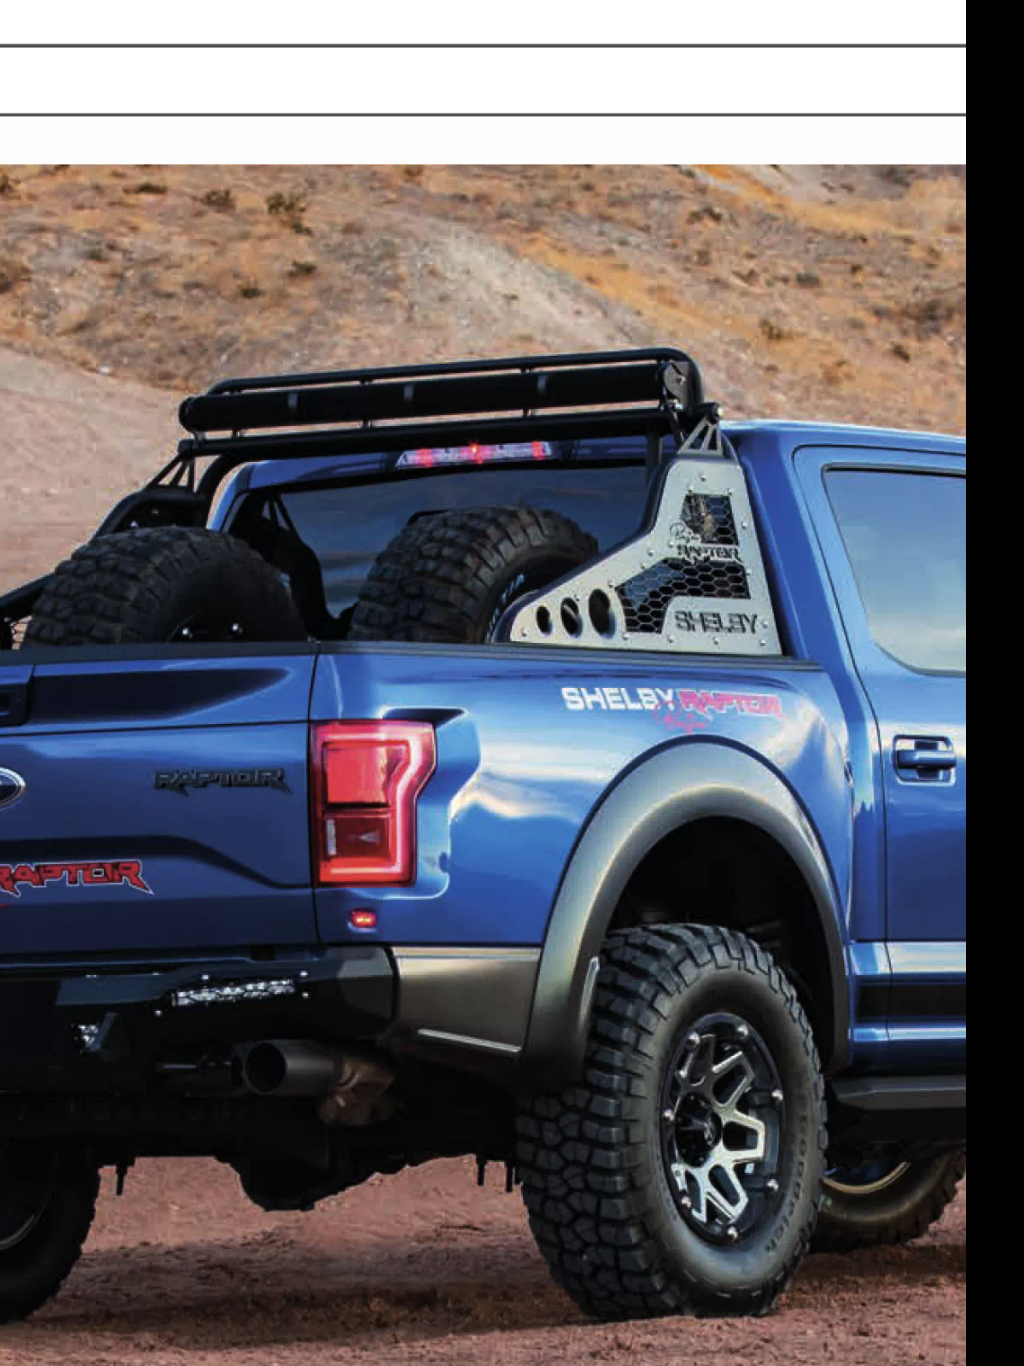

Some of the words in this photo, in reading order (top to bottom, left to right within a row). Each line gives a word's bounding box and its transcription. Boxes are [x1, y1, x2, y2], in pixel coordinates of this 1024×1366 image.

[674, 610, 758, 635] SHELBY
[560, 687, 676, 711] SHELBY
[153, 768, 294, 798] RAPTOR
